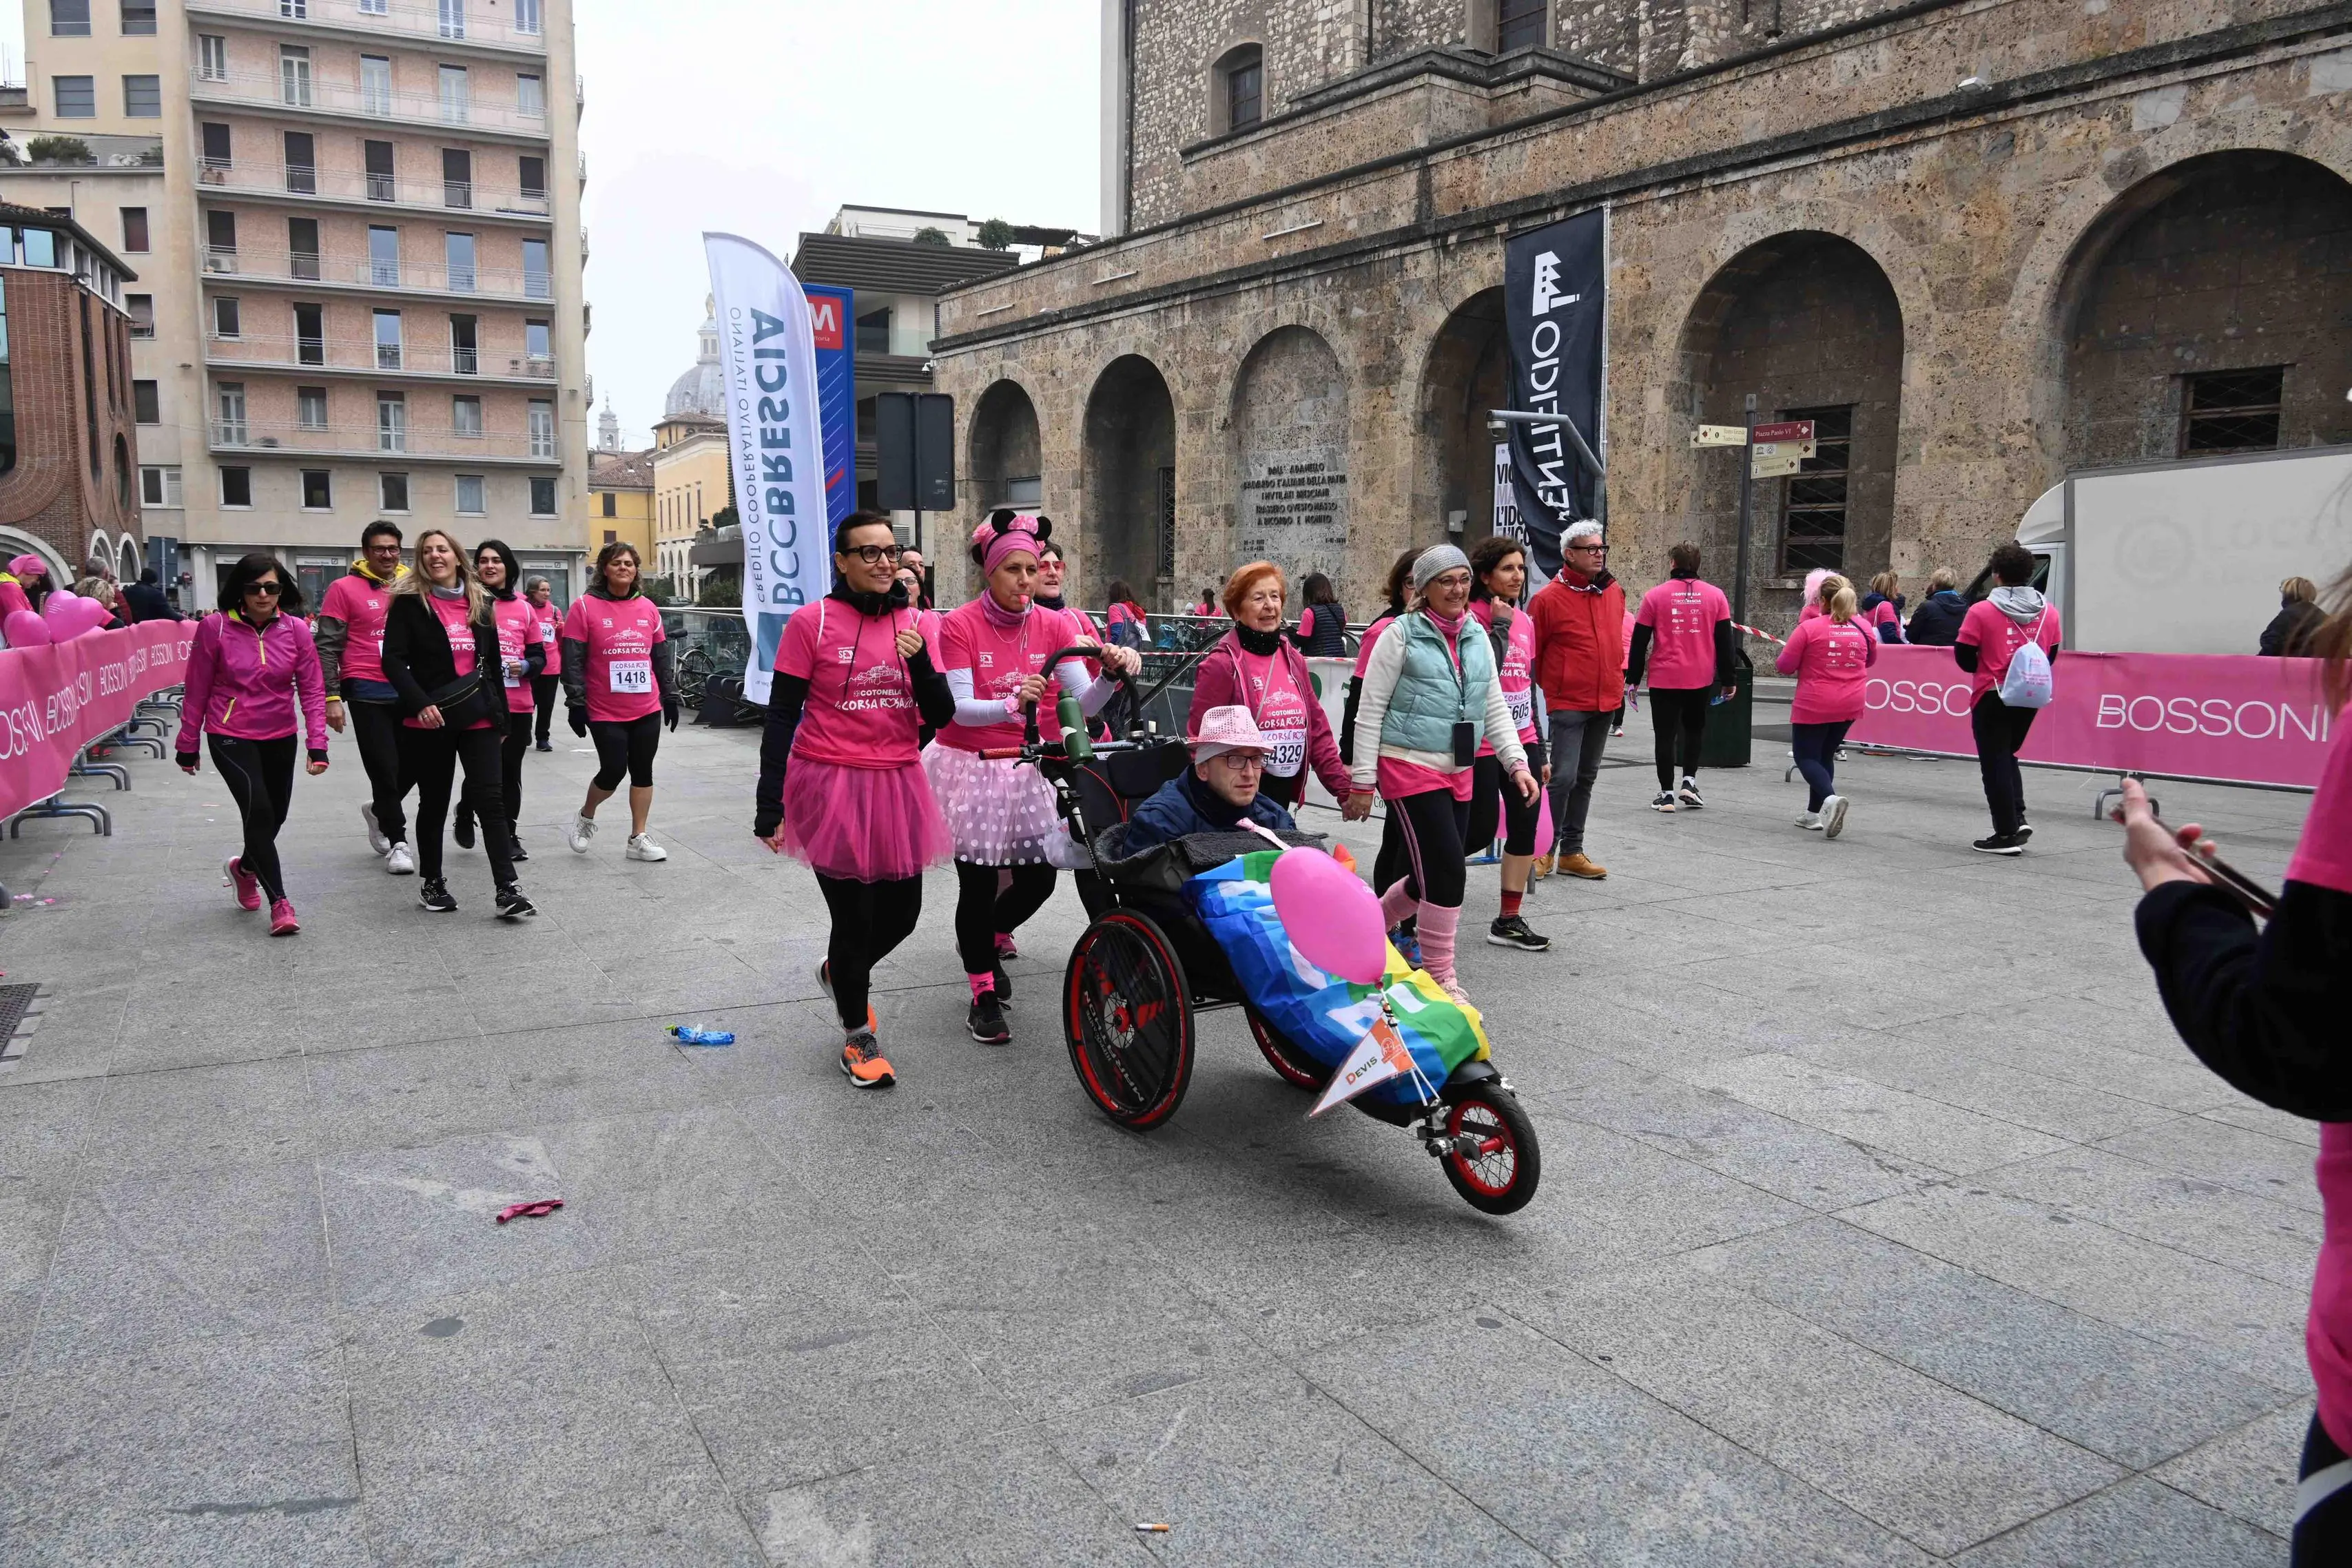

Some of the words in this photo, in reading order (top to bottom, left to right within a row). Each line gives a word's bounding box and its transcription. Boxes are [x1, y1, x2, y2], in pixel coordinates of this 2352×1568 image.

[541, 628, 552, 637] 94
[608, 647, 630, 655] CORSA
[616, 670, 647, 684] 1418
[1864, 678, 1972, 717] OSSO
[842, 699, 878, 711] CORSA
[1508, 701, 1529, 721] 605
[1259, 719, 1286, 729] CORSA
[2096, 694, 2331, 743] BOSSONI
[1266, 731, 1292, 741] CORSA
[1084, 990, 1145, 1103] MARATHON
[1345, 1056, 1378, 1086] DEVIS
